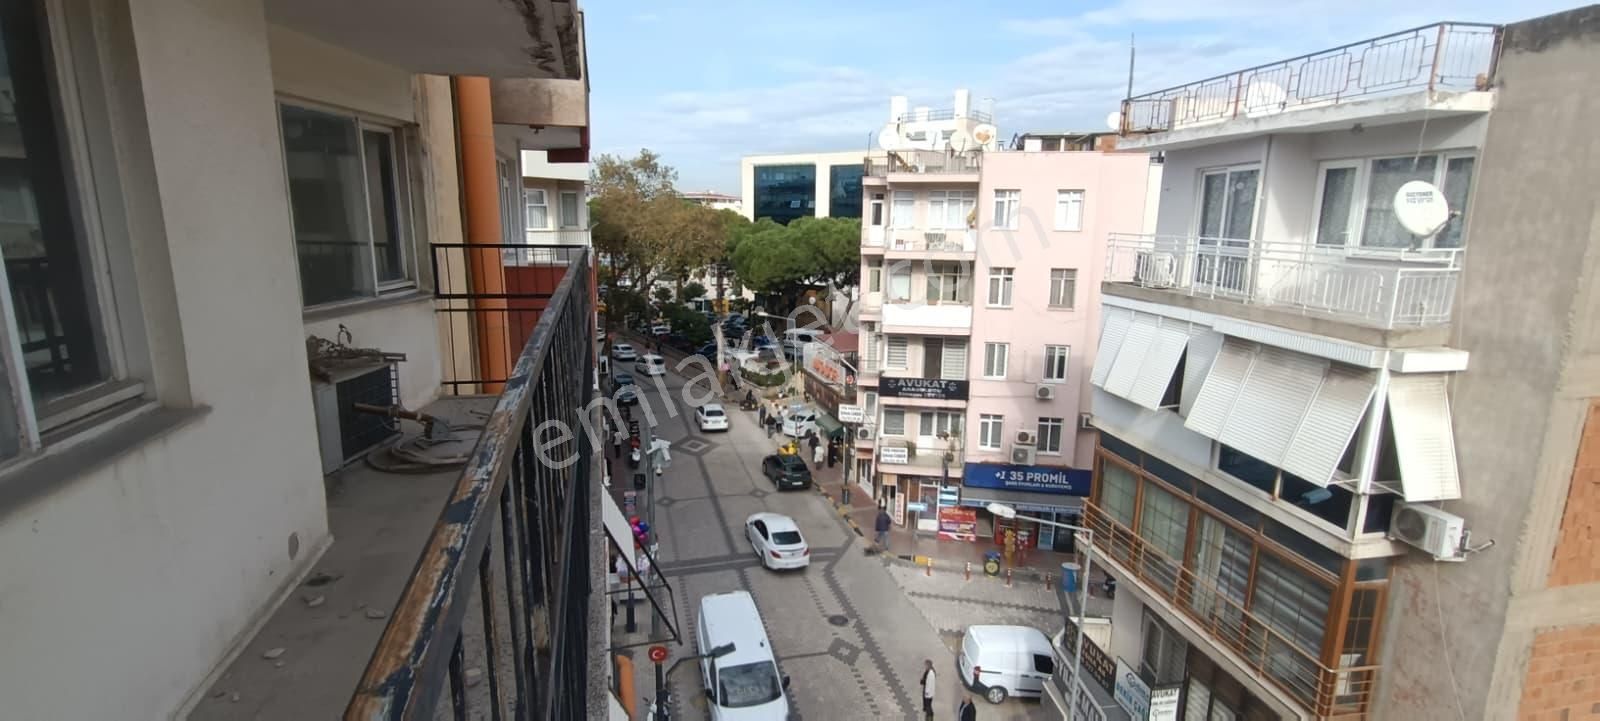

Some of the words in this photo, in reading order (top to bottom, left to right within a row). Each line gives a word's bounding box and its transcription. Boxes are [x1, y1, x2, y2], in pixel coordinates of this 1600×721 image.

[898, 378, 947, 388] AVUKAT
[1010, 471, 1024, 481] 35
[1026, 471, 1069, 484] PROMİL
